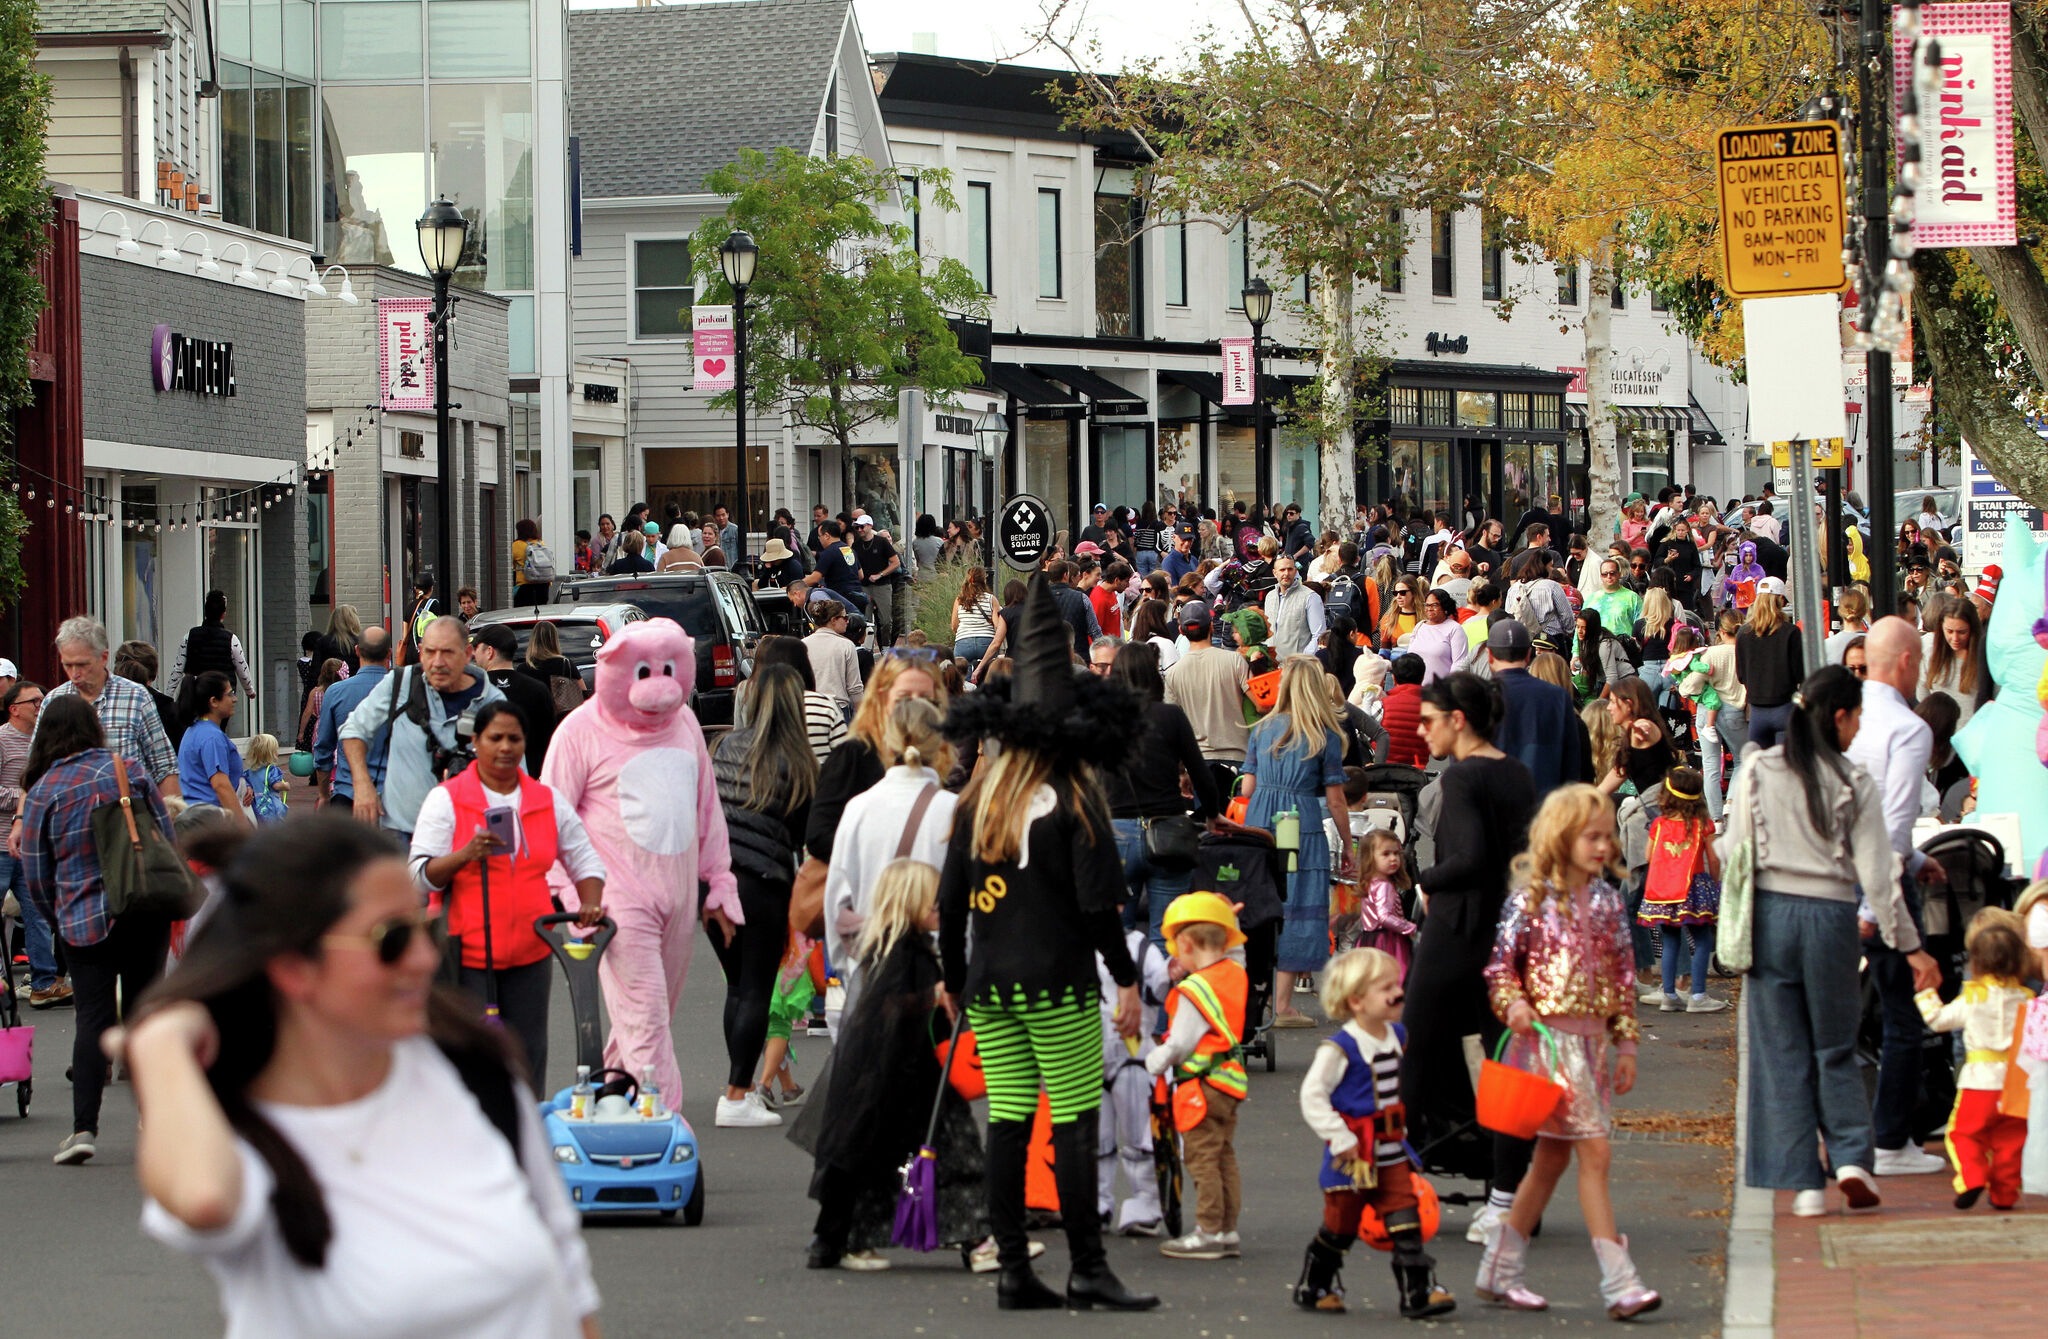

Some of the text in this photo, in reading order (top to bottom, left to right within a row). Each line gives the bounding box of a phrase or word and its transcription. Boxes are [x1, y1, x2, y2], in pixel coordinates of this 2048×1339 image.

[1722, 129, 1835, 159] LOADING ZONE
[1726, 160, 1835, 184] COMMERCIAL
[1741, 184, 1823, 205] VEHICLES
[1733, 205, 1834, 229] NO PARKING
[1744, 228, 1827, 248] 8AM-NOON
[1753, 249, 1820, 267] MON-FRI
[171, 333, 237, 397] ATHLETA
[1611, 370, 1662, 382] ELICATESSEN
[1778, 478, 1792, 486] DRIV
[1972, 502, 2004, 510] RETAIL
[1980, 510, 2030, 519] FOR LSE
[1010, 533, 1040, 542] BEDFORD
[1011, 540, 1040, 548] SQUARE
